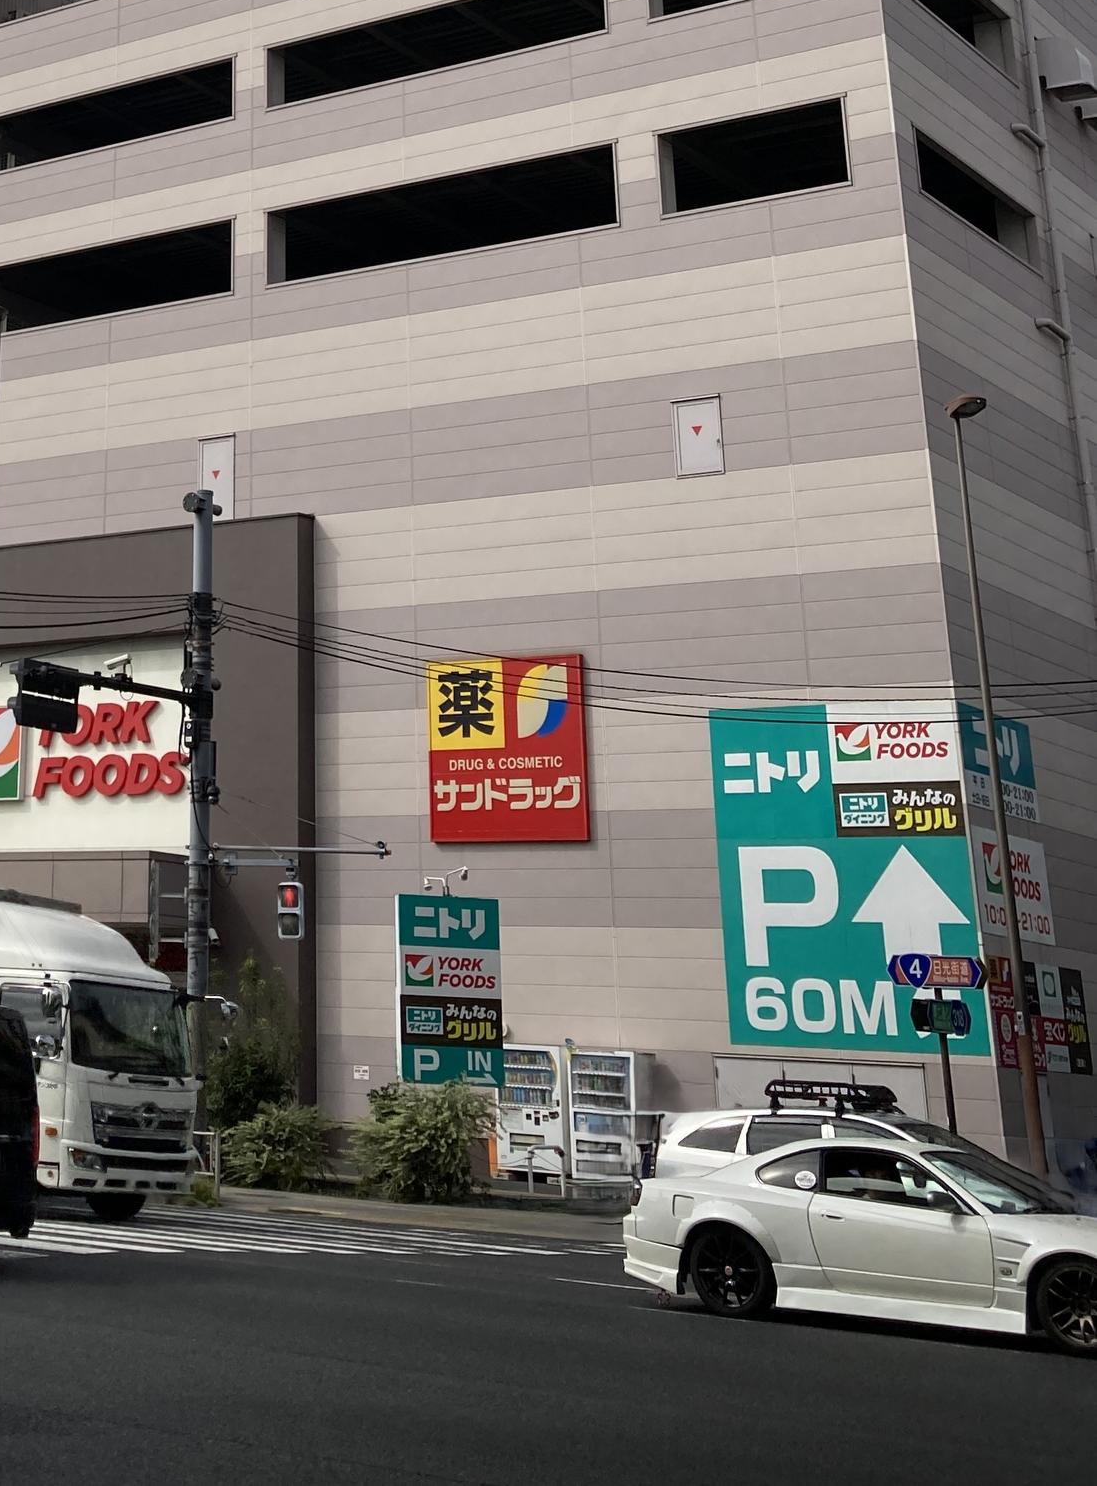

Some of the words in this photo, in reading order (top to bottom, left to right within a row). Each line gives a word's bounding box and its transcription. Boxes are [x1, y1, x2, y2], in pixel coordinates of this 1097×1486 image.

[438, 669, 495, 738] 薬
[875, 721, 930, 739] YORK
[877, 742, 949, 759] FOODS
[449, 758, 484, 771] DRUG
[487, 758, 495, 770] &
[498, 756, 563, 770] COSMETIC
[724, 750, 820, 793] ニトリ
[33, 751, 190, 800] FOODS
[434, 775, 582, 812] サンドラッグ
[849, 797, 878, 810] ニトリ
[892, 788, 956, 807] みんなの
[843, 814, 885, 824] ダイニング
[894, 808, 957, 831] グリル
[1009, 850, 1030, 874] ORK
[1013, 876, 1041, 901] OODS
[738, 845, 839, 967] P
[414, 906, 485, 940] ニトリ
[984, 903, 1050, 935] 10:0-21:00
[438, 957, 484, 972] YORK
[910, 958, 923, 979] 4
[933, 960, 969, 976] 日光街道
[438, 974, 496, 989] FOODS
[413, 1010, 436, 1021] ニトリ
[446, 1004, 497, 1021] みんなの
[746, 976, 898, 1036] 60M
[446, 1021, 497, 1041] グリル
[414, 1049, 440, 1081] P
[467, 1051, 492, 1072] IN
